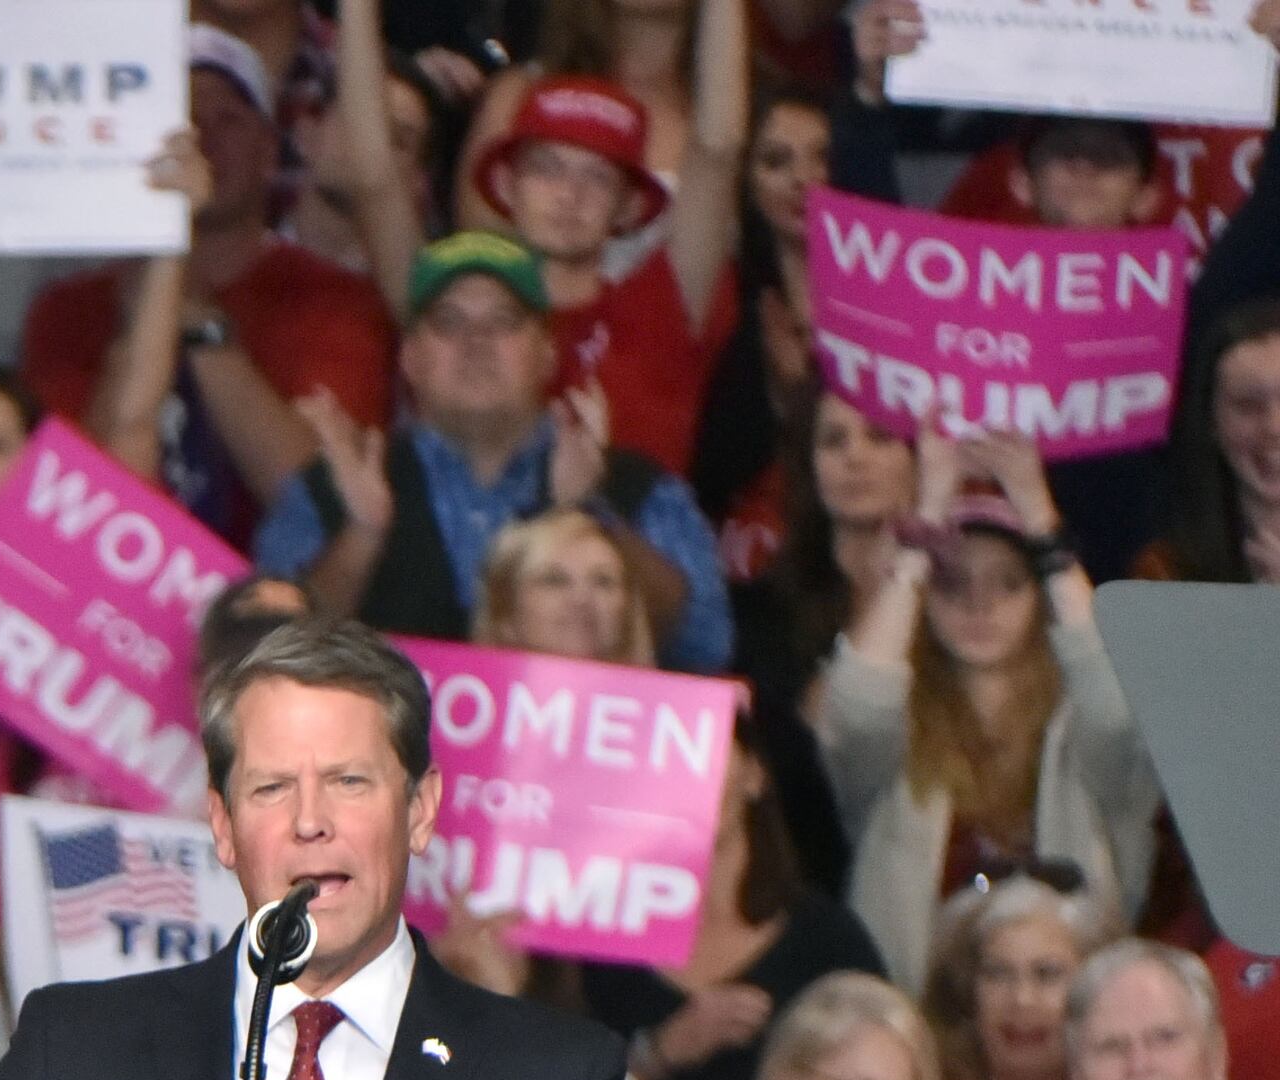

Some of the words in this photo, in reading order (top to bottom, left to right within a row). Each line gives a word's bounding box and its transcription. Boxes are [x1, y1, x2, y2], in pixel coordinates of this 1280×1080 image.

[822, 211, 1174, 314] WOMEN
[814, 328, 1172, 442] TRUMP
[934, 320, 1034, 370] FOR
[25, 446, 230, 632] WOM
[78, 598, 174, 680] FOR
[424, 672, 714, 776] OMEN
[452, 775, 554, 823] FOR
[407, 836, 700, 934] RUMP
